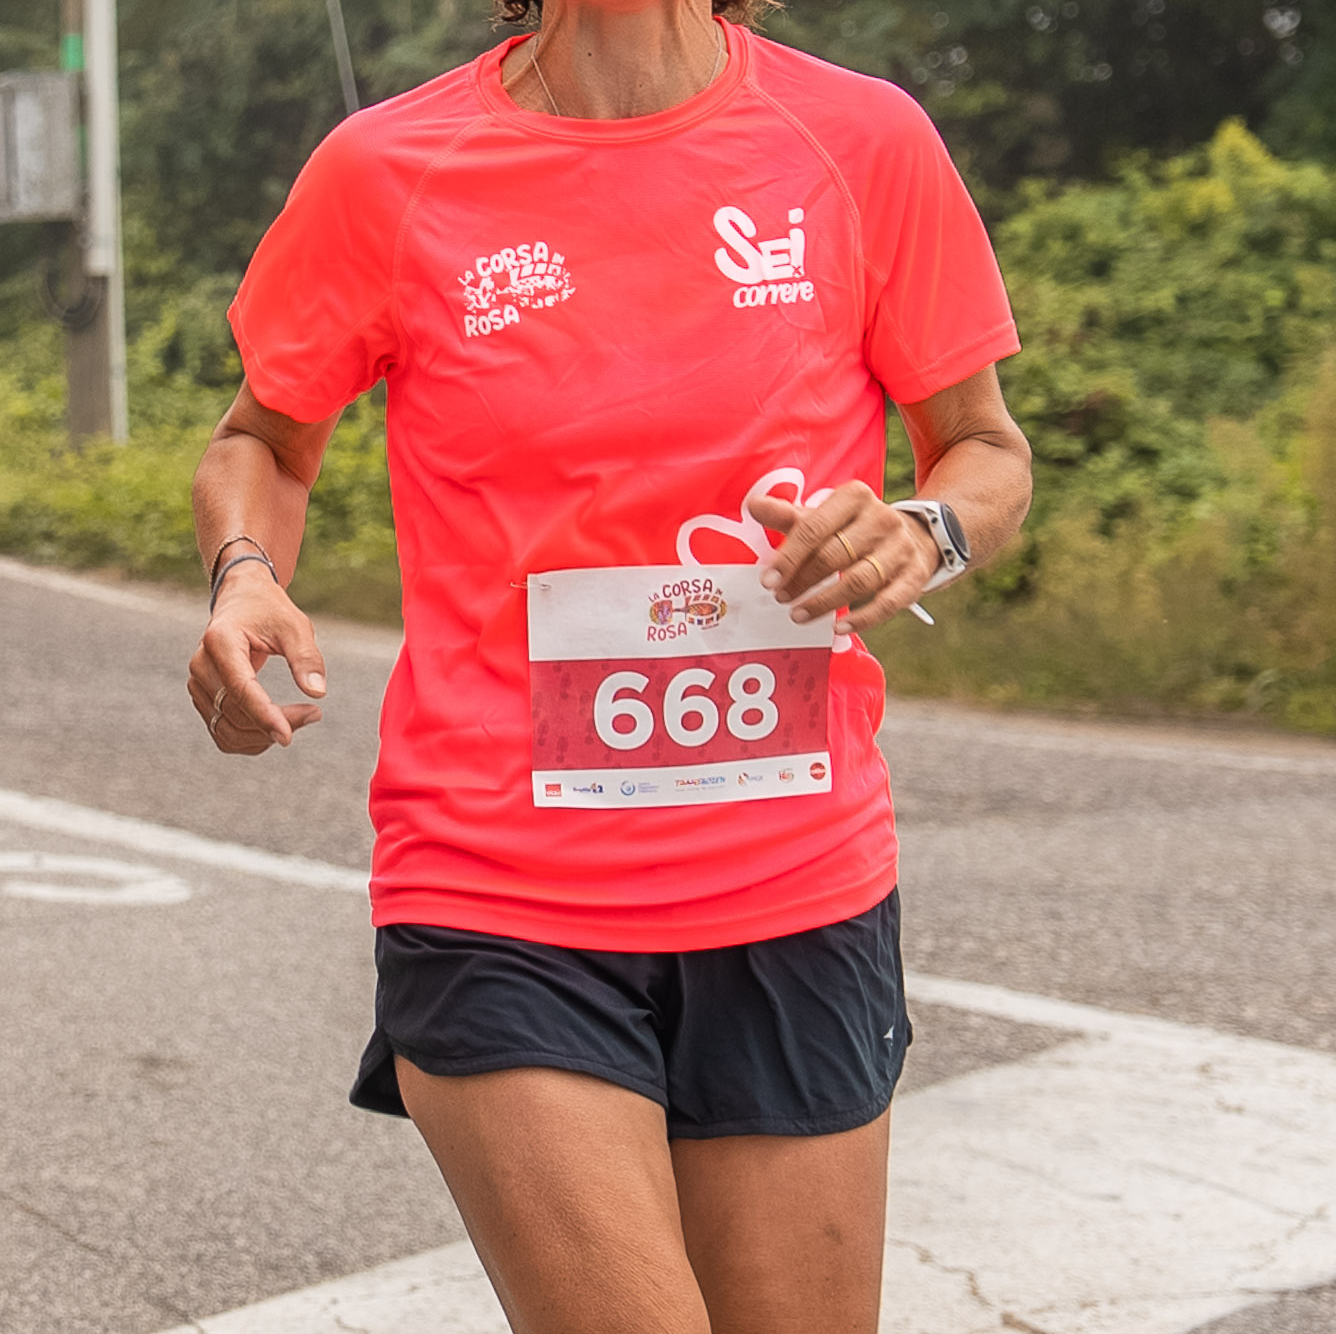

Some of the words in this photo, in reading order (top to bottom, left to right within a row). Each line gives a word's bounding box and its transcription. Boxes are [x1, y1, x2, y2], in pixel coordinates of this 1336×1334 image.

[475, 241, 549, 277] CORSA
[733, 281, 814, 308] correre
[464, 304, 520, 337] ROSA
[662, 578, 713, 598] CORSA
[647, 622, 687, 642] ROSA
[593, 662, 780, 751] 668
